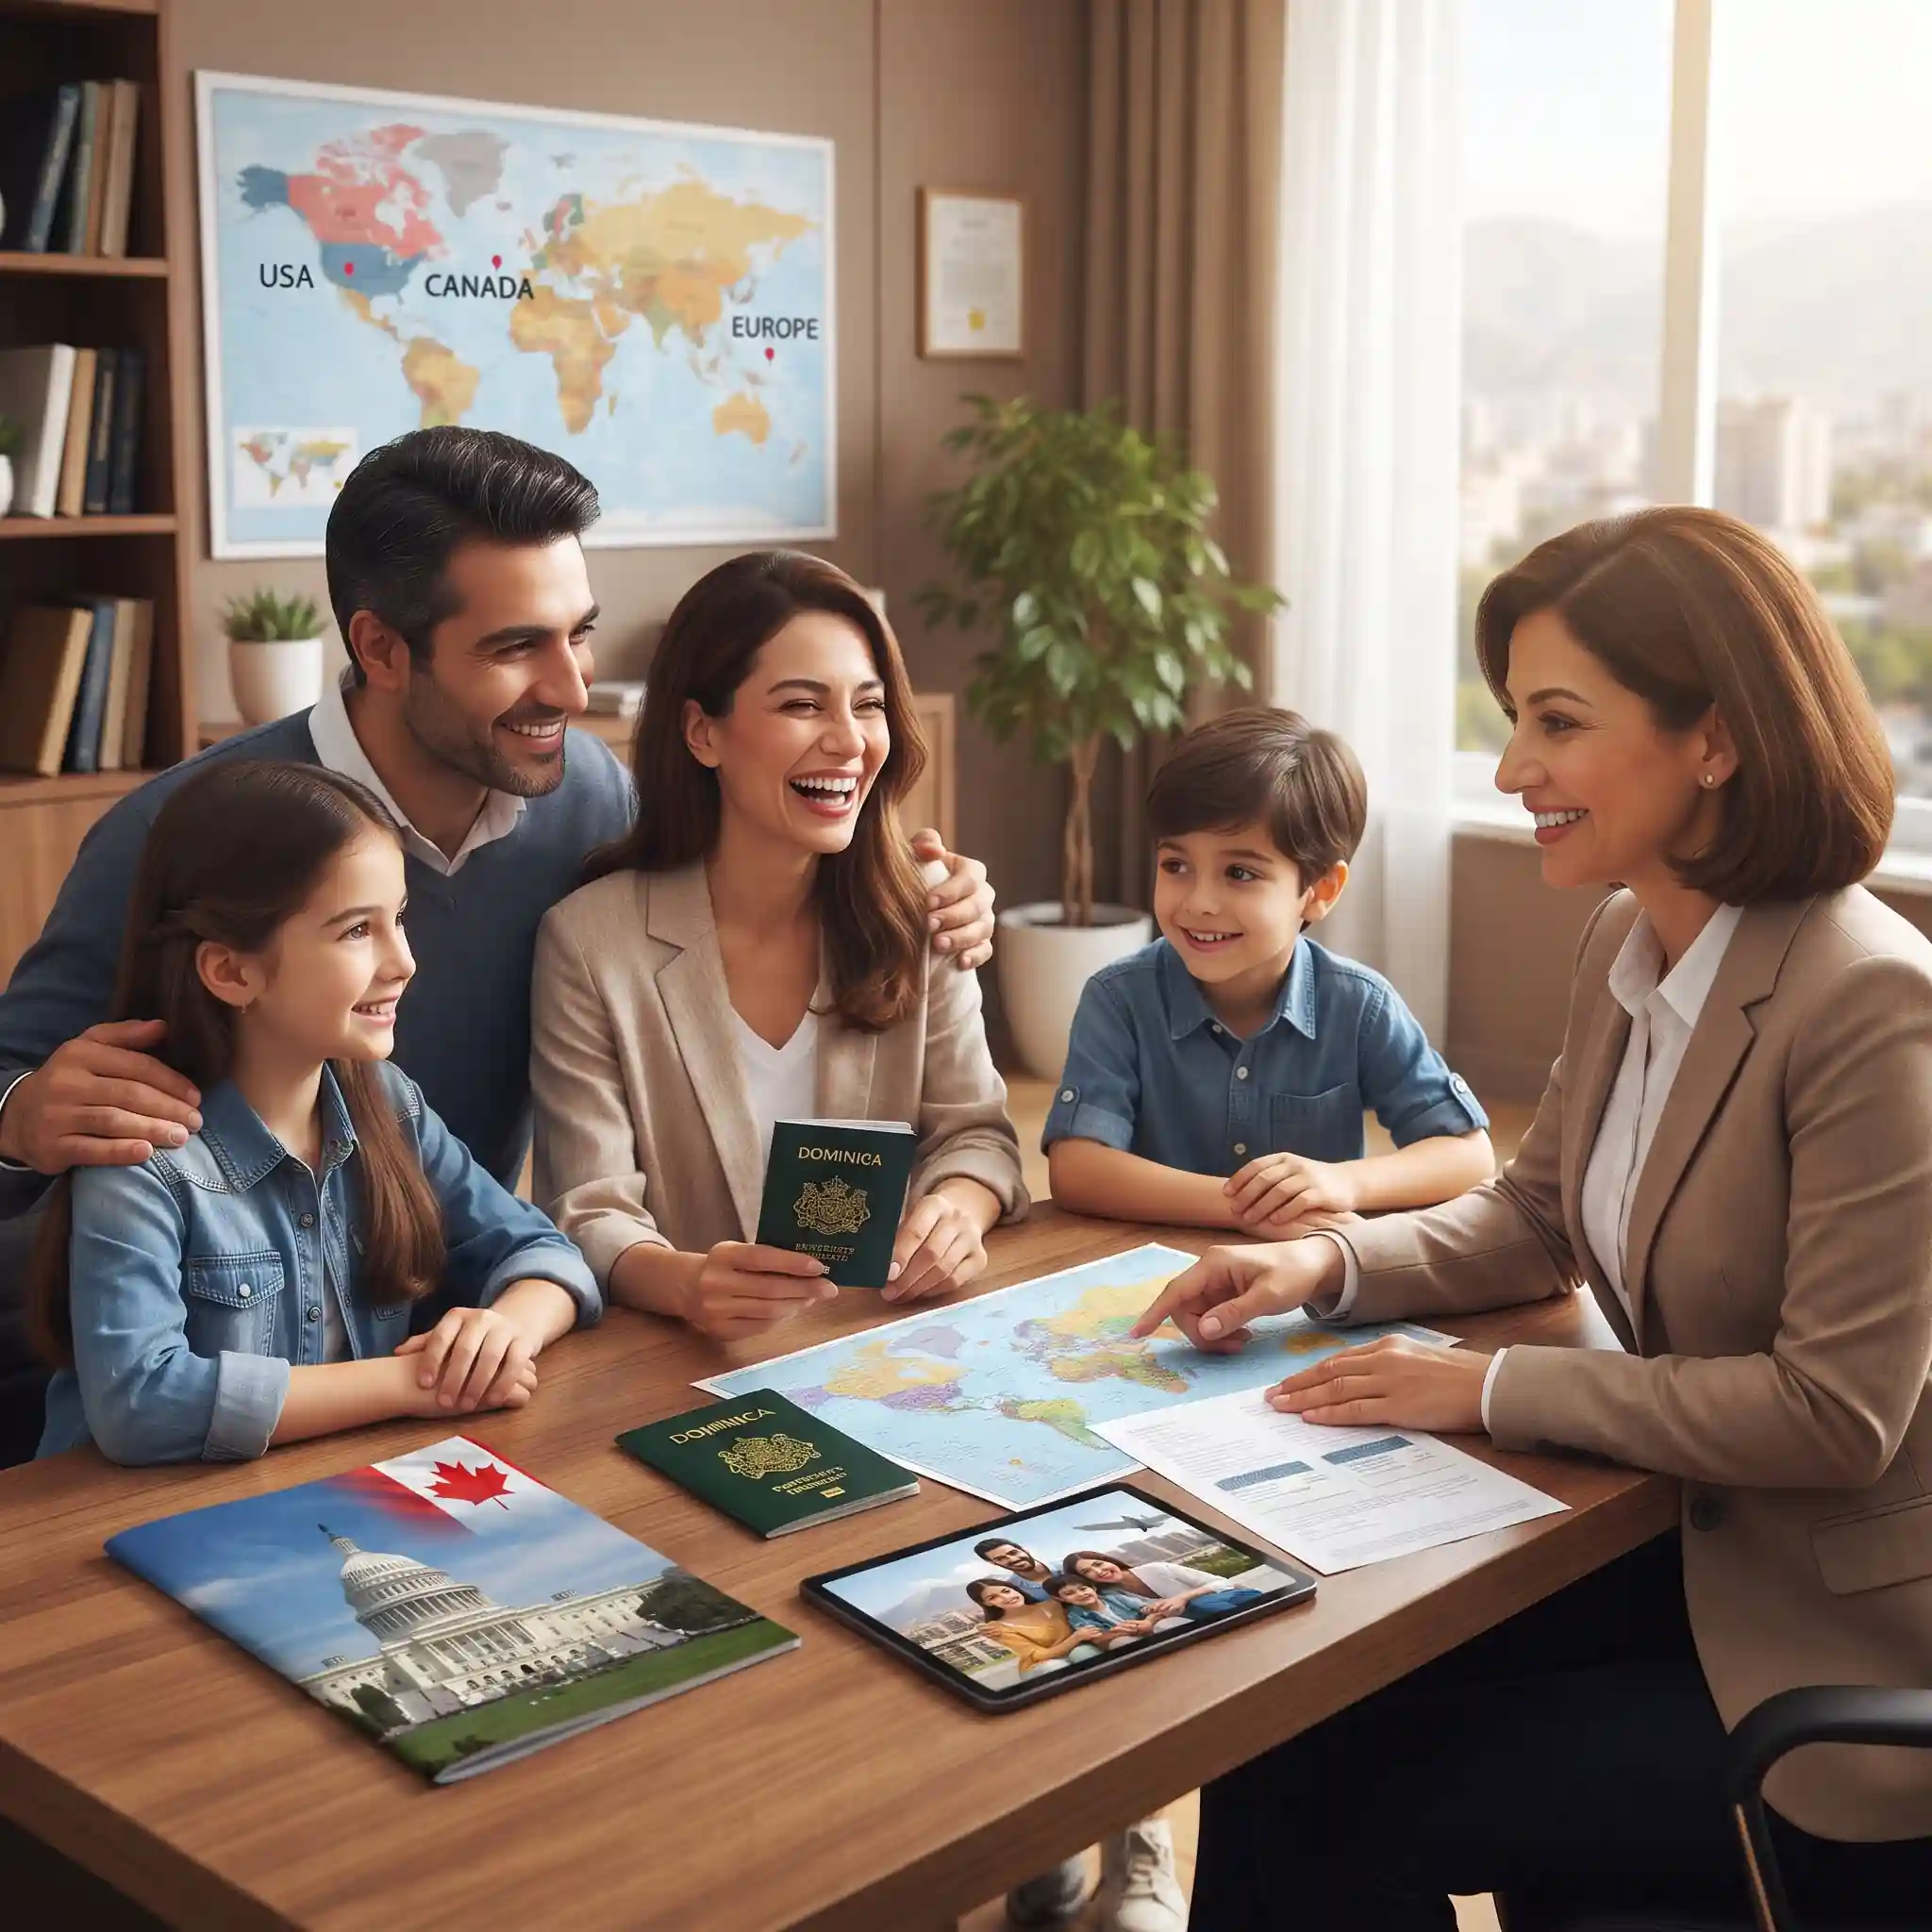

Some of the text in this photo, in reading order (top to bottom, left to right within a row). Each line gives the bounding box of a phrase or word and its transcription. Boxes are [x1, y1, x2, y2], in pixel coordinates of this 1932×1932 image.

[259, 263, 314, 289] USA
[425, 274, 534, 300] CANADA
[732, 315, 819, 340] EUROPE
[798, 1146, 882, 1167] DOMINICA
